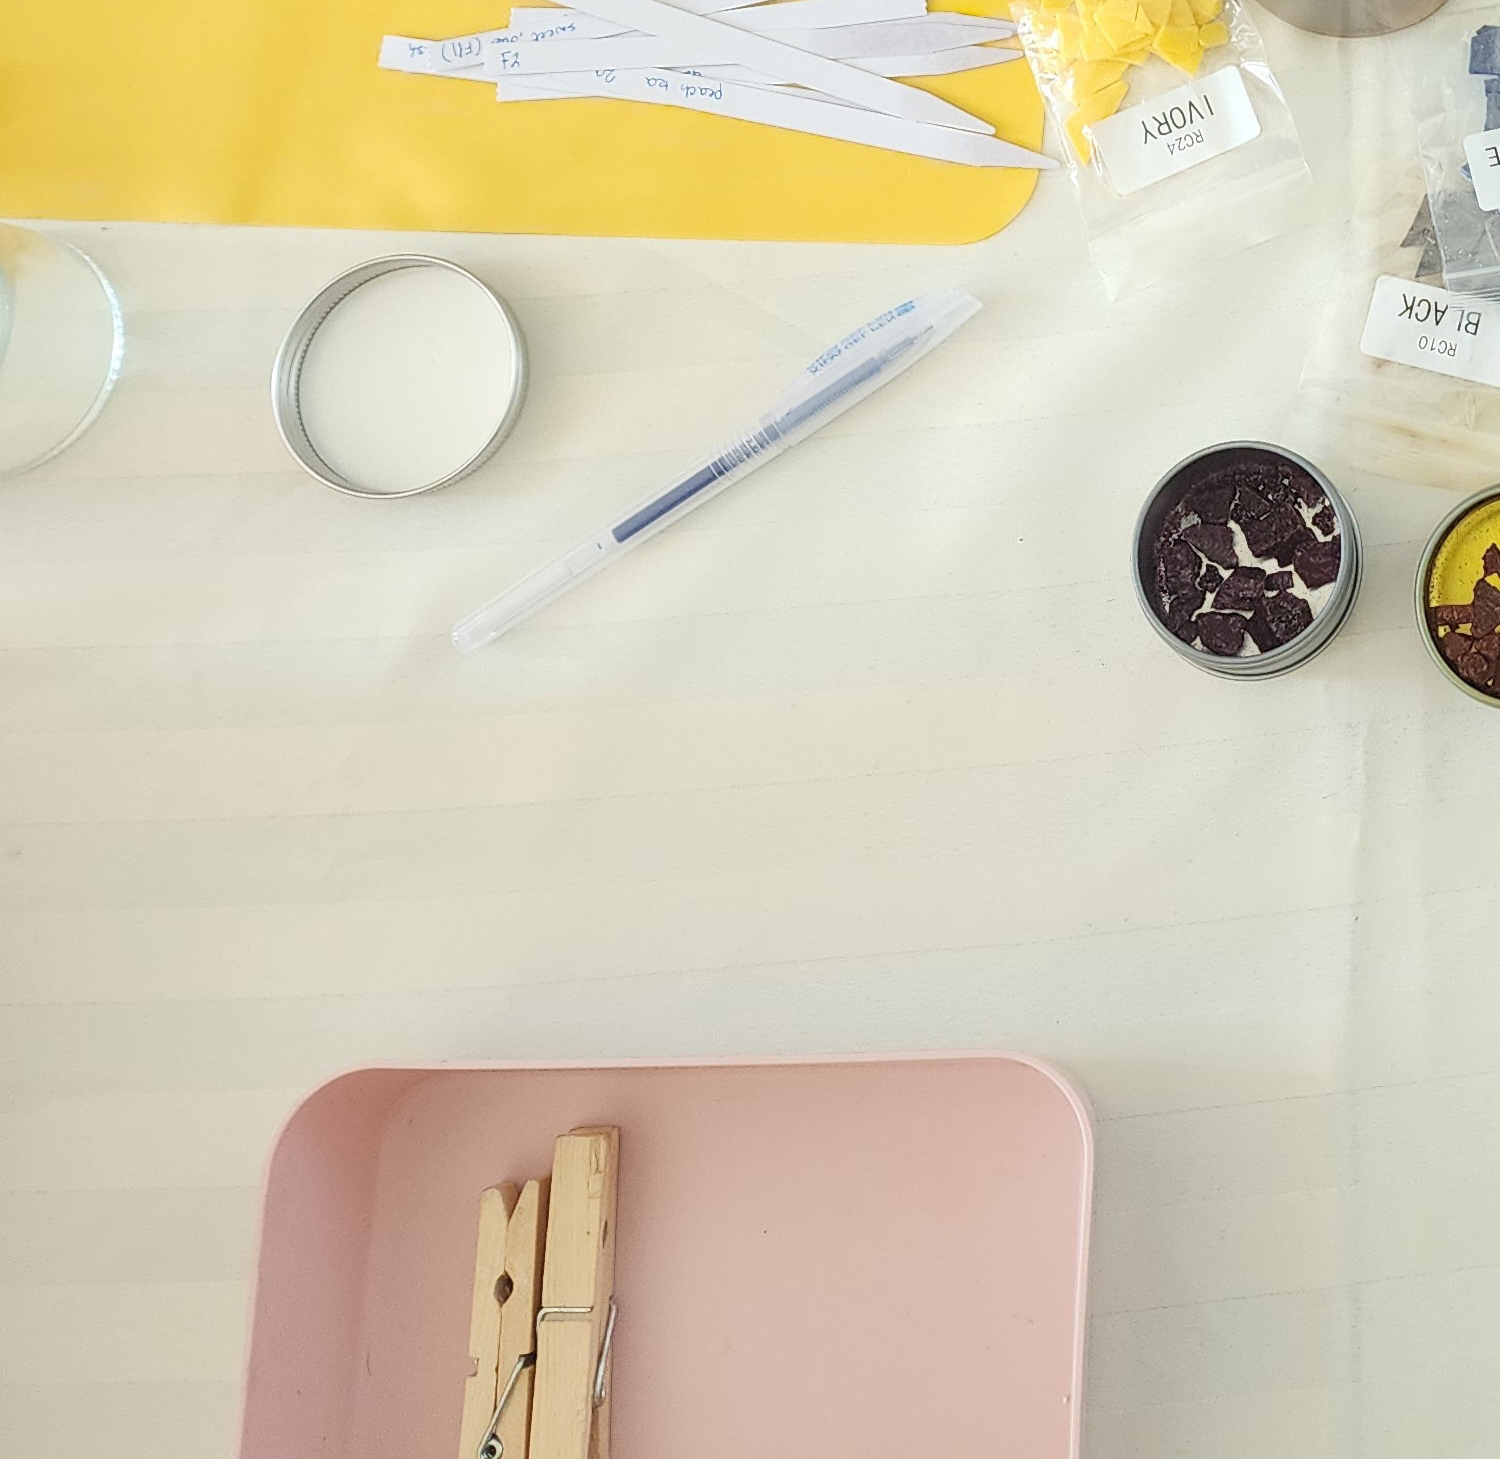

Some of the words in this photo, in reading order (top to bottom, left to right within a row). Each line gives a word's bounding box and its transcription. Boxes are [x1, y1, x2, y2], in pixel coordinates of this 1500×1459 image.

[1139, 93, 1214, 142] IVORY
[1166, 128, 1205, 155] RC24
[1398, 293, 1482, 336] BLACK
[1418, 335, 1458, 358] RC10
